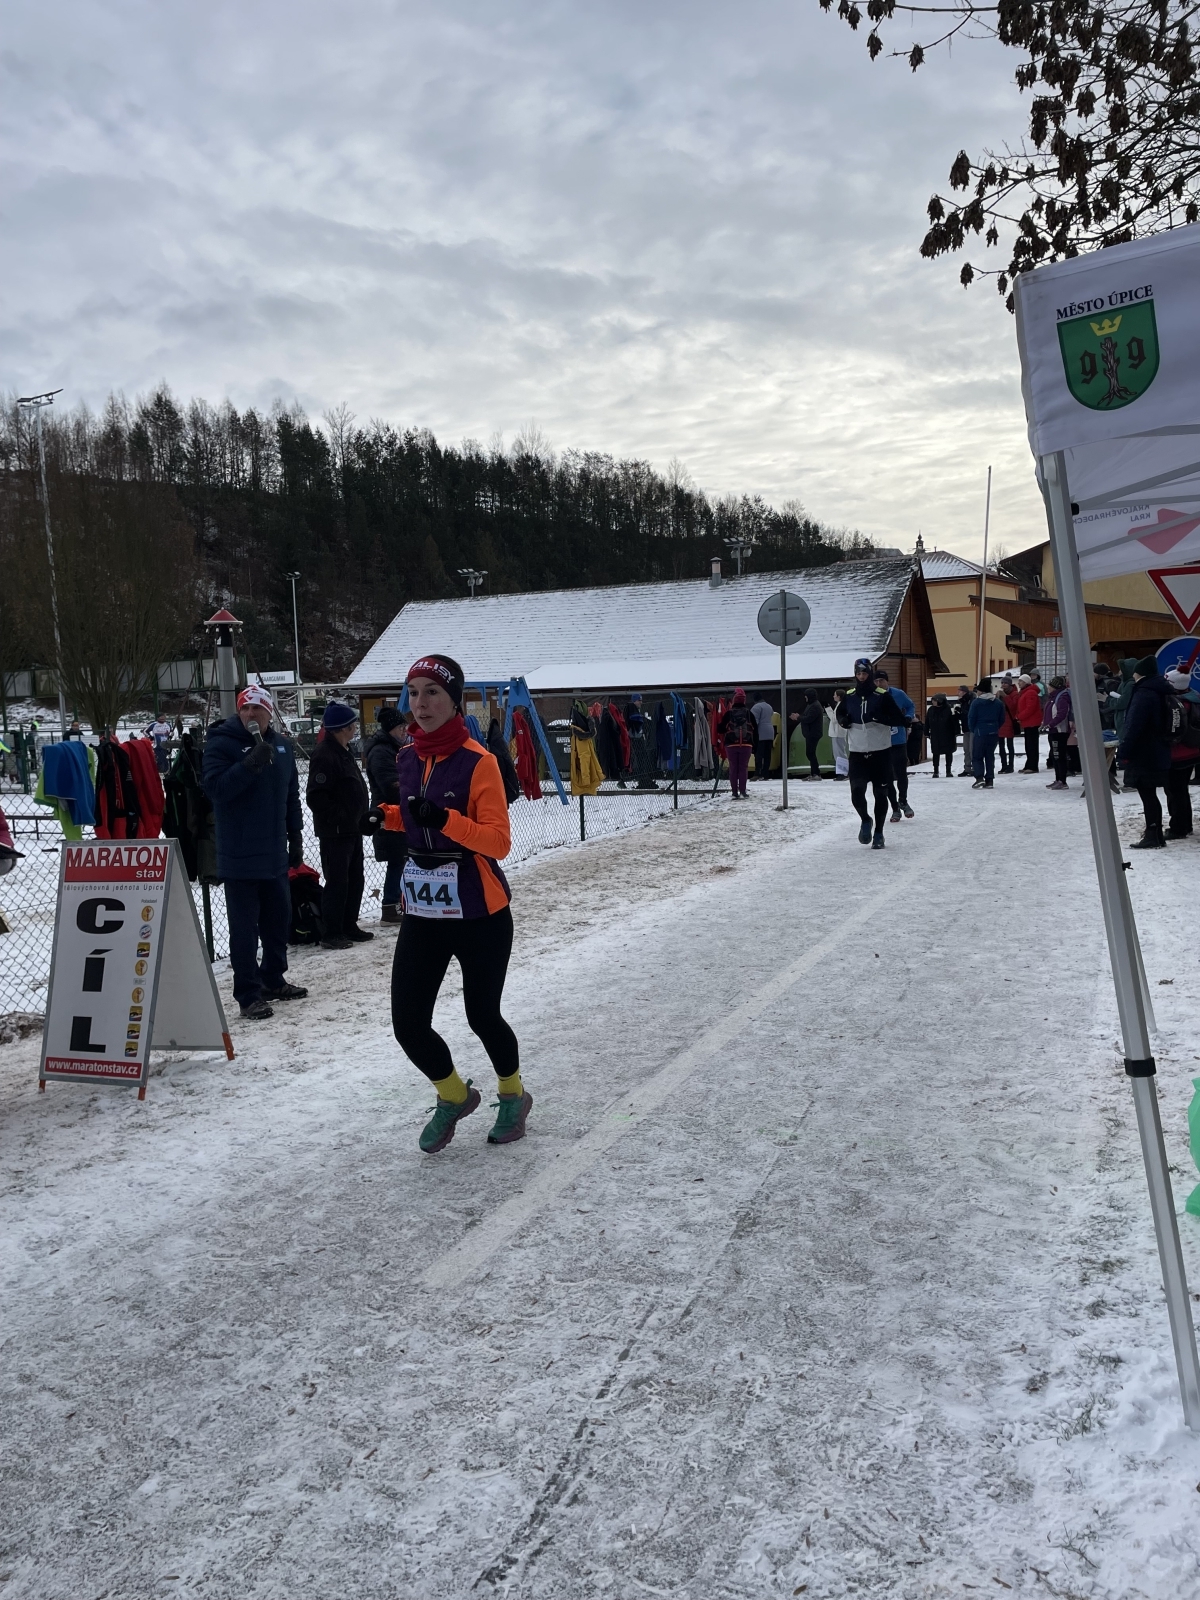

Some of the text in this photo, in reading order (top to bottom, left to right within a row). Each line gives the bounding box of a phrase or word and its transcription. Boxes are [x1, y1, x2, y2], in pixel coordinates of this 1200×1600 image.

[1056, 284, 1153, 320] MĚSTO ÚPICE
[66, 846, 169, 867] MARATON
[135, 868, 162, 878] stav
[112, 883, 140, 892] jednota
[143, 882, 164, 891] Úpice
[405, 881, 453, 906] 144
[69, 897, 126, 1053] CÍL
[48, 1058, 138, 1076] www.maratonstav.cz
